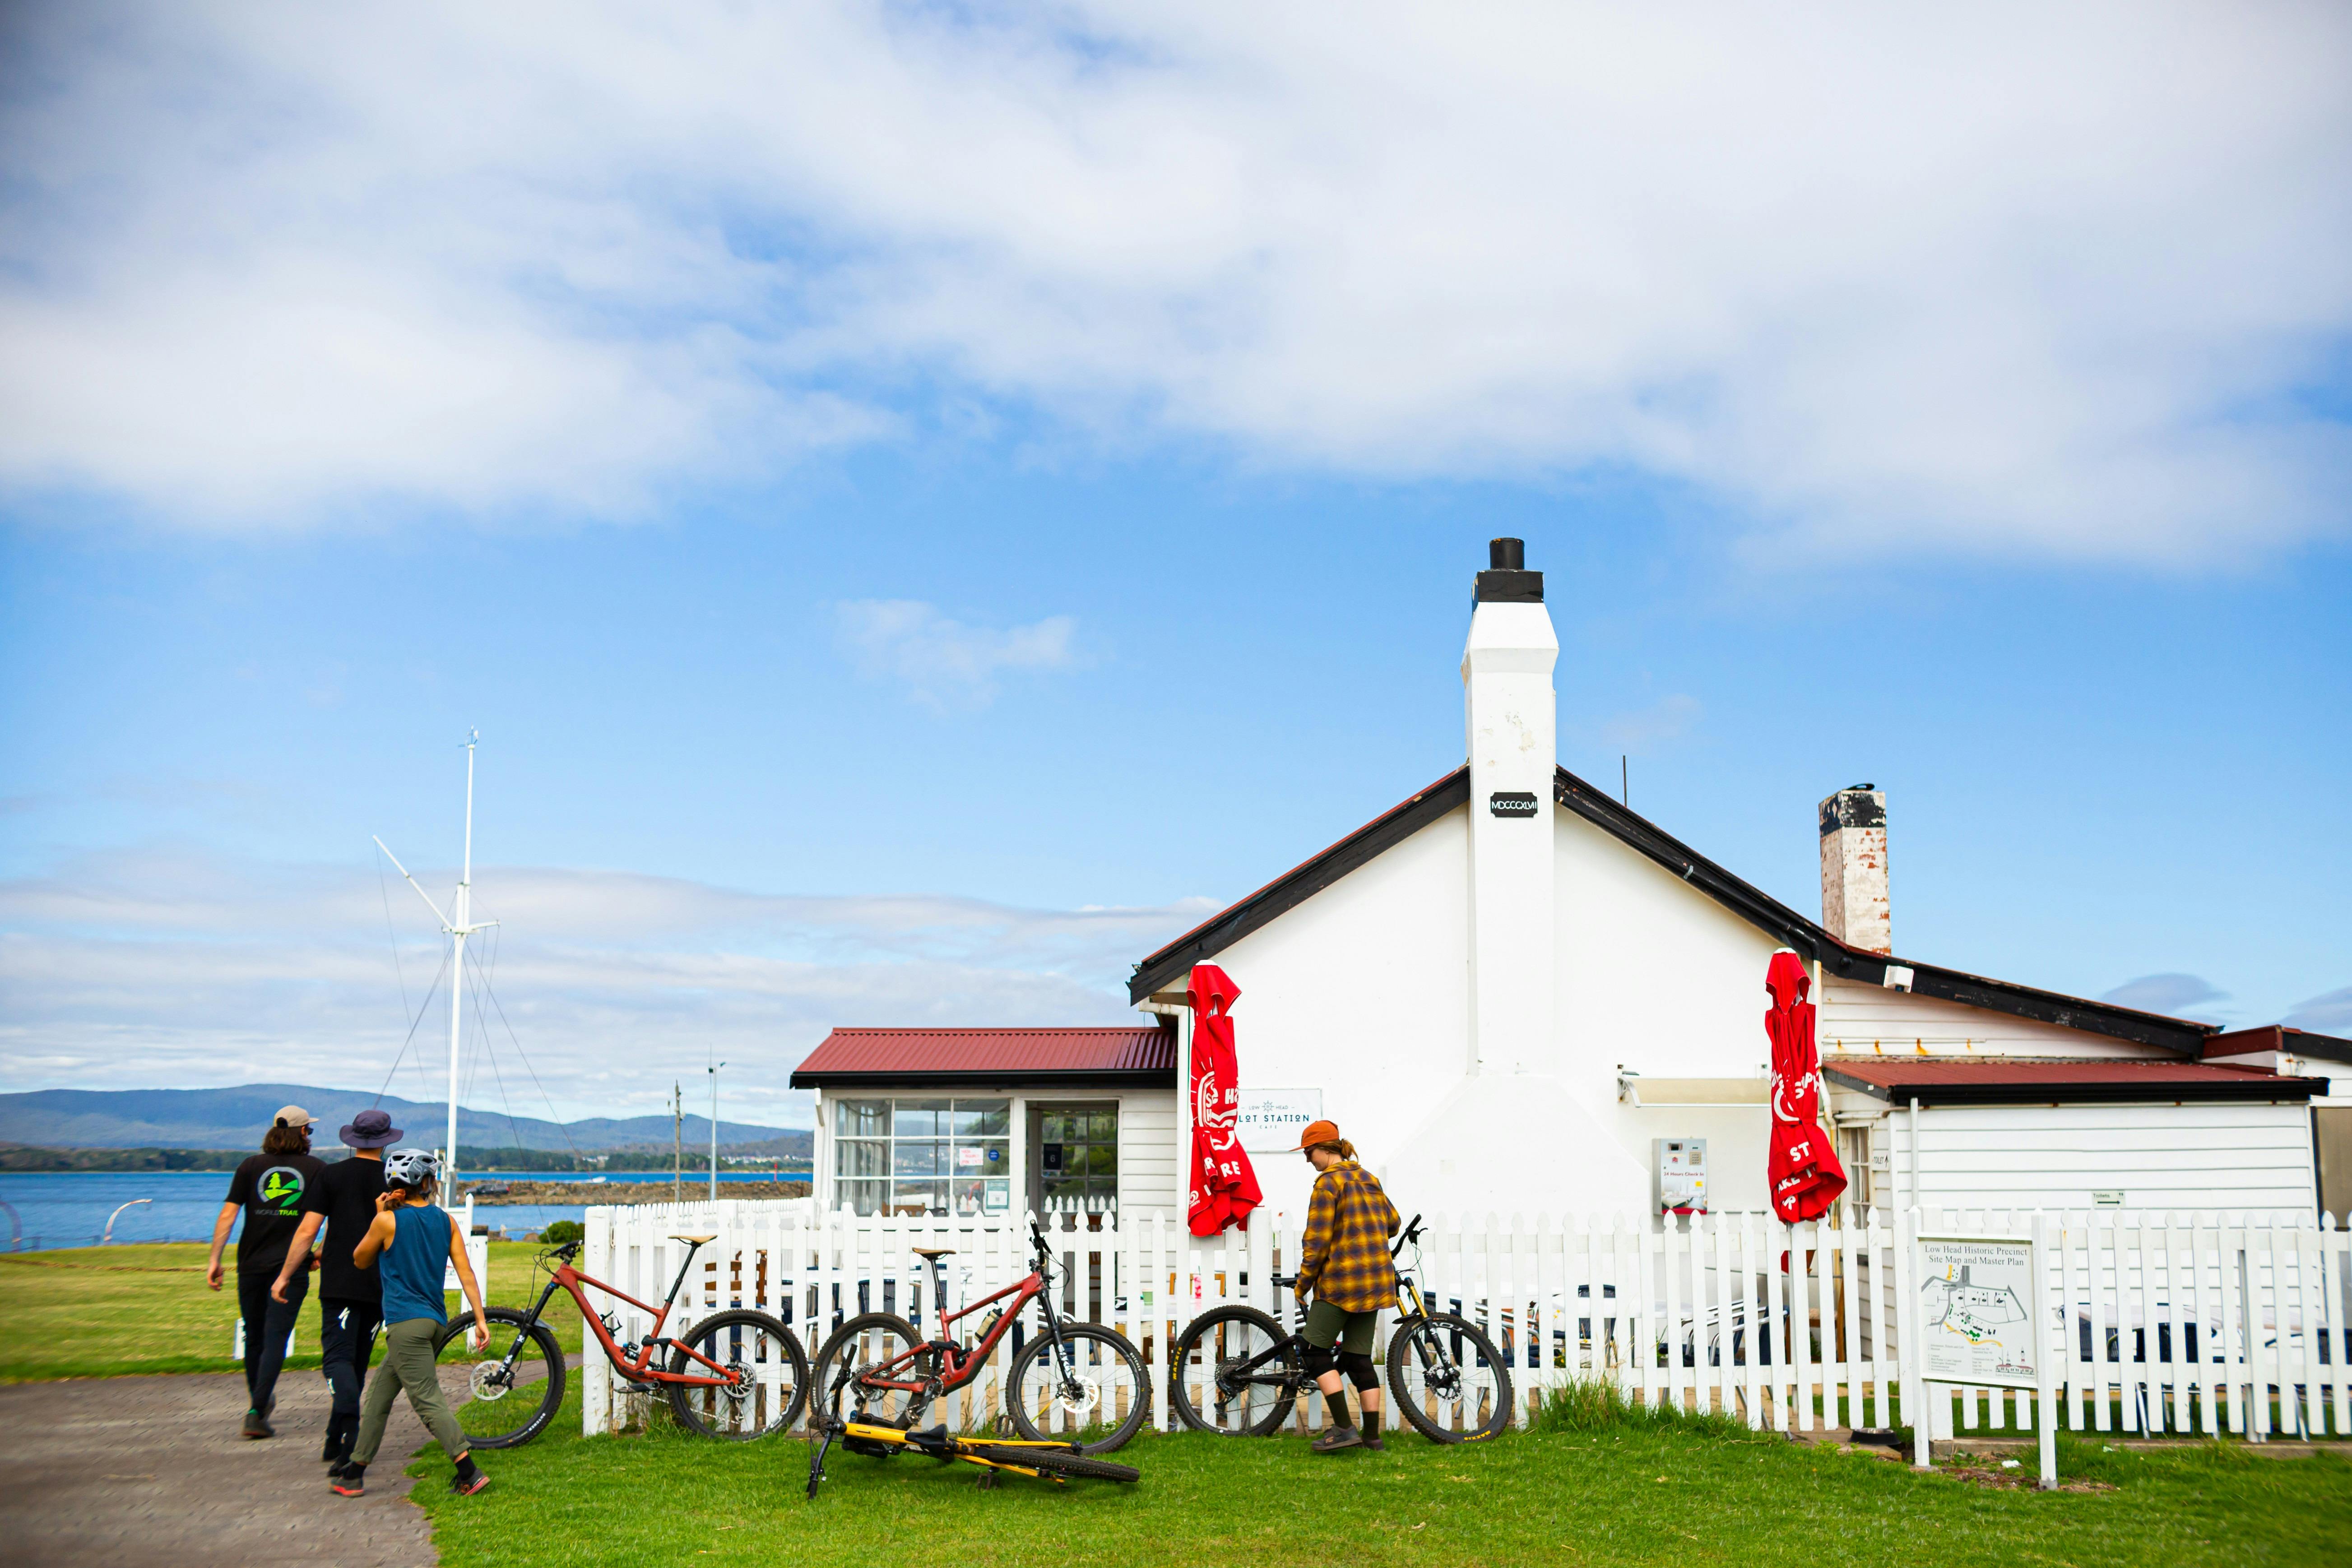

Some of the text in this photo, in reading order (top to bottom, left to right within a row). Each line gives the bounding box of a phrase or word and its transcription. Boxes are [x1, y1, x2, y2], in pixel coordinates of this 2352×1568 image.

[1925, 1245, 2027, 1256] Low Head Historic Precinct
[1945, 1256, 1962, 1265] Map
[1979, 1257, 2005, 1265] Master
[2007, 1258, 2024, 1266] Plan
[1173, 1346, 1183, 1380] MAXXIS
[1464, 1429, 1491, 1441] MAXXIS
